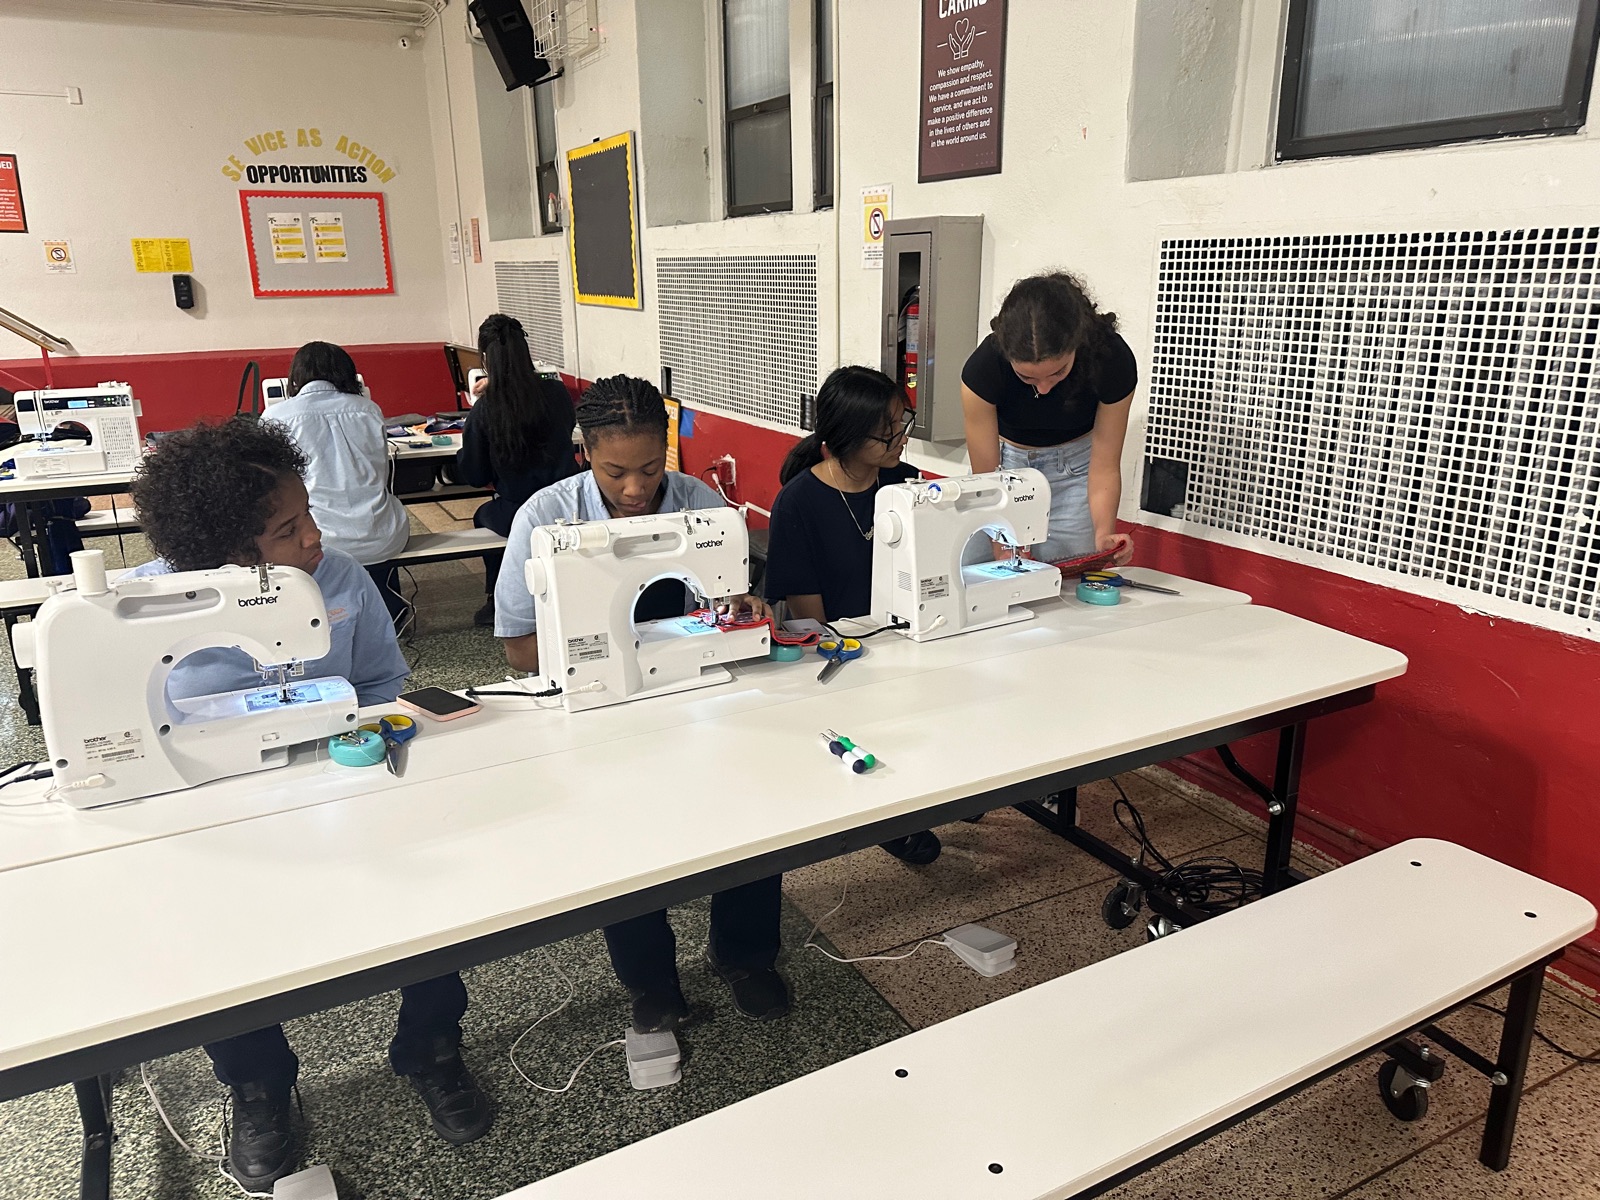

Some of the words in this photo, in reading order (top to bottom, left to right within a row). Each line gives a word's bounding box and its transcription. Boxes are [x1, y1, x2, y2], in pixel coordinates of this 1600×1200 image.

[939, 0, 987, 18] CAR
[938, 69, 946, 78] We
[947, 67, 960, 76] show
[961, 60, 984, 71] empathy,
[930, 78, 959, 91] compassion
[960, 74, 970, 84] and
[971, 69, 993, 81] respect.
[954, 83, 986, 97] commitment
[933, 104, 952, 114] service,
[953, 100, 963, 109] and
[972, 96, 981, 105] act
[928, 117, 940, 125] make
[946, 112, 965, 124] positive
[966, 107, 993, 118] difference
[956, 123, 961, 132] of
[962, 121, 978, 130] others
[980, 118, 990, 128] and
[946, 136, 959, 145] world
[960, 132, 978, 143] around
[0, 161, 12, 169] ED
[297, 128, 322, 148] AS
[335, 134, 396, 184] ACTION
[246, 165, 367, 184] OPPORTUNITIES
[696, 540, 723, 549] brother
[238, 596, 278, 607] brother
